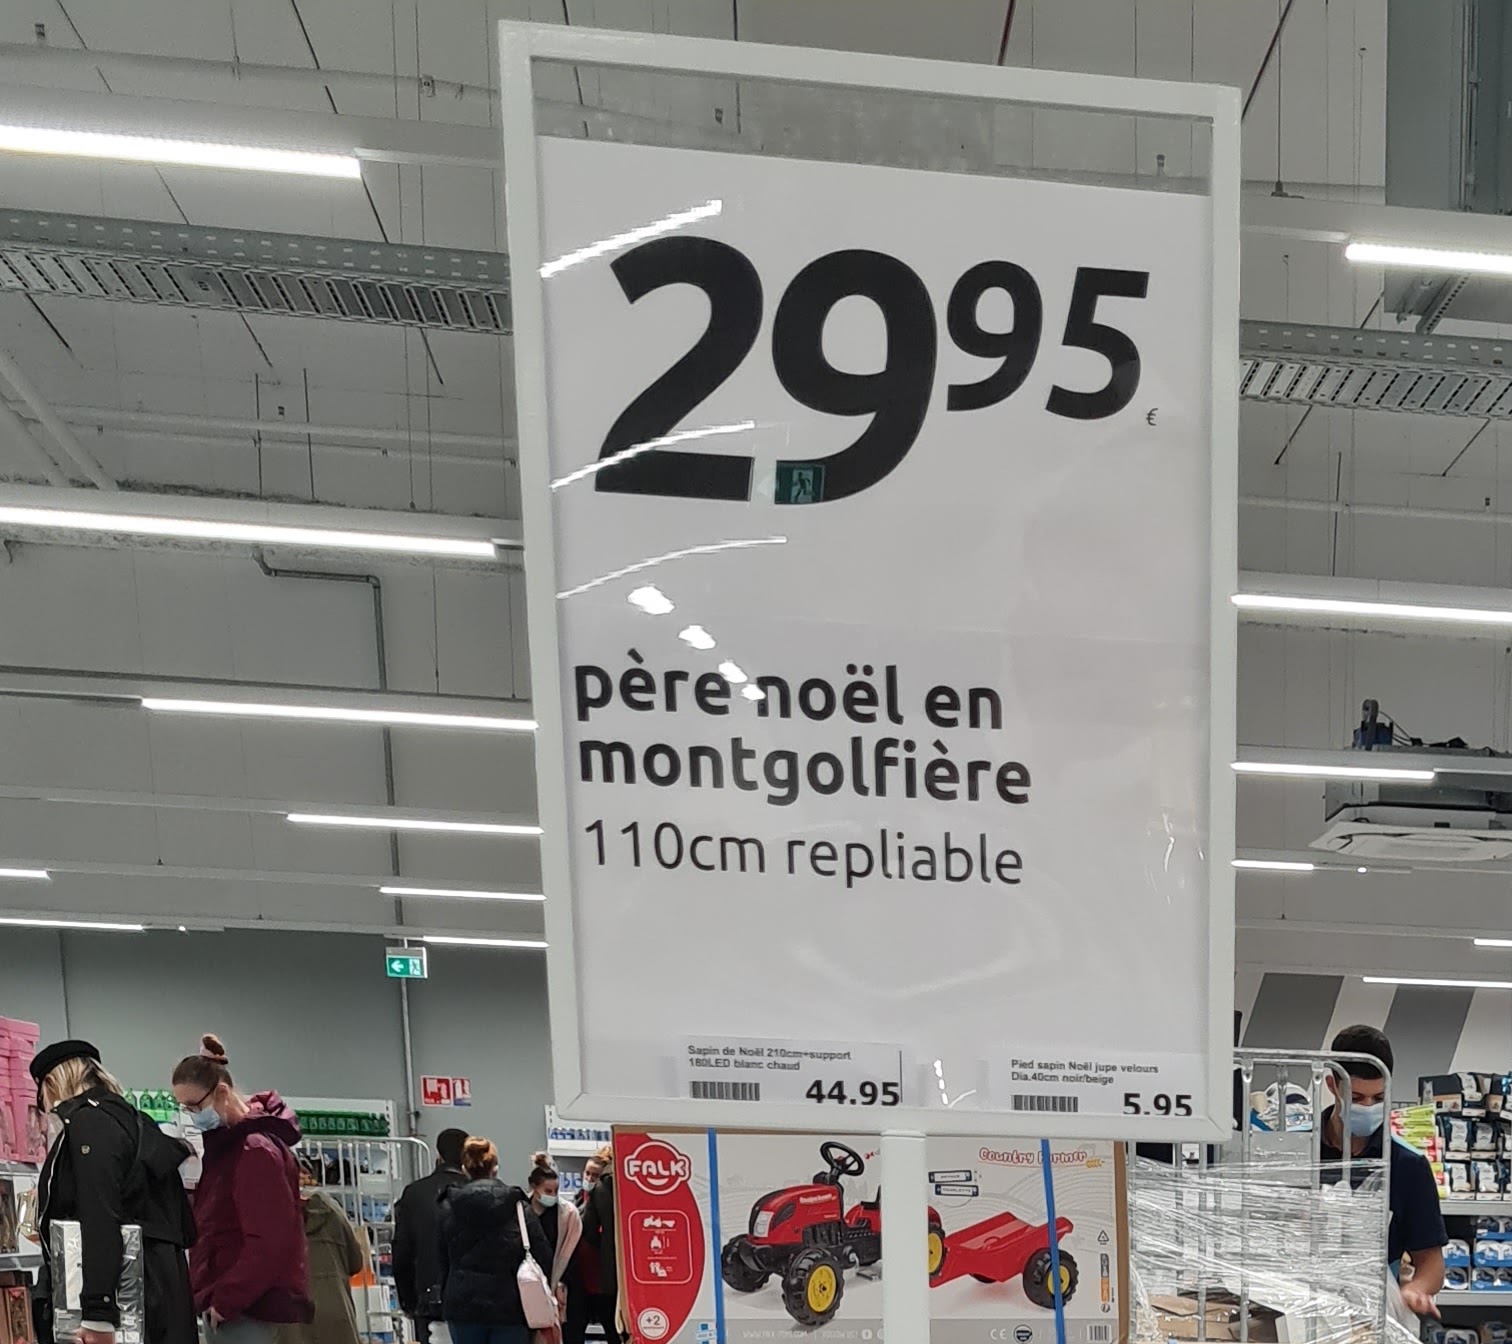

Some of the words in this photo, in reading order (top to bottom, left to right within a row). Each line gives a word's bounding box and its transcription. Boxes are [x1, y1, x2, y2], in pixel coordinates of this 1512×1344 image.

[575, 649, 731, 721] père
[757, 664, 904, 725] noël
[925, 686, 1002, 729] en
[580, 736, 1031, 806] montgolfière
[586, 820, 764, 873] 110cm
[788, 829, 1023, 889] repliable
[688, 1044, 720, 1057] Sapin
[723, 1046, 736, 1056] de
[739, 1046, 765, 1057] Noël
[733, 1059, 764, 1069] blanc
[767, 1060, 801, 1071] chaud
[1011, 1059, 1035, 1070] Pied
[1037, 1060, 1066, 1072] sapin
[1068, 1061, 1093, 1071] Noël
[1095, 1062, 1118, 1074] jupe
[1120, 1064, 1159, 1074] velours
[805, 1079, 901, 1107] 44.95
[1122, 1092, 1193, 1117] 5.95
[979, 1146, 1035, 1165] Country
[629, 1159, 686, 1177] FALK
